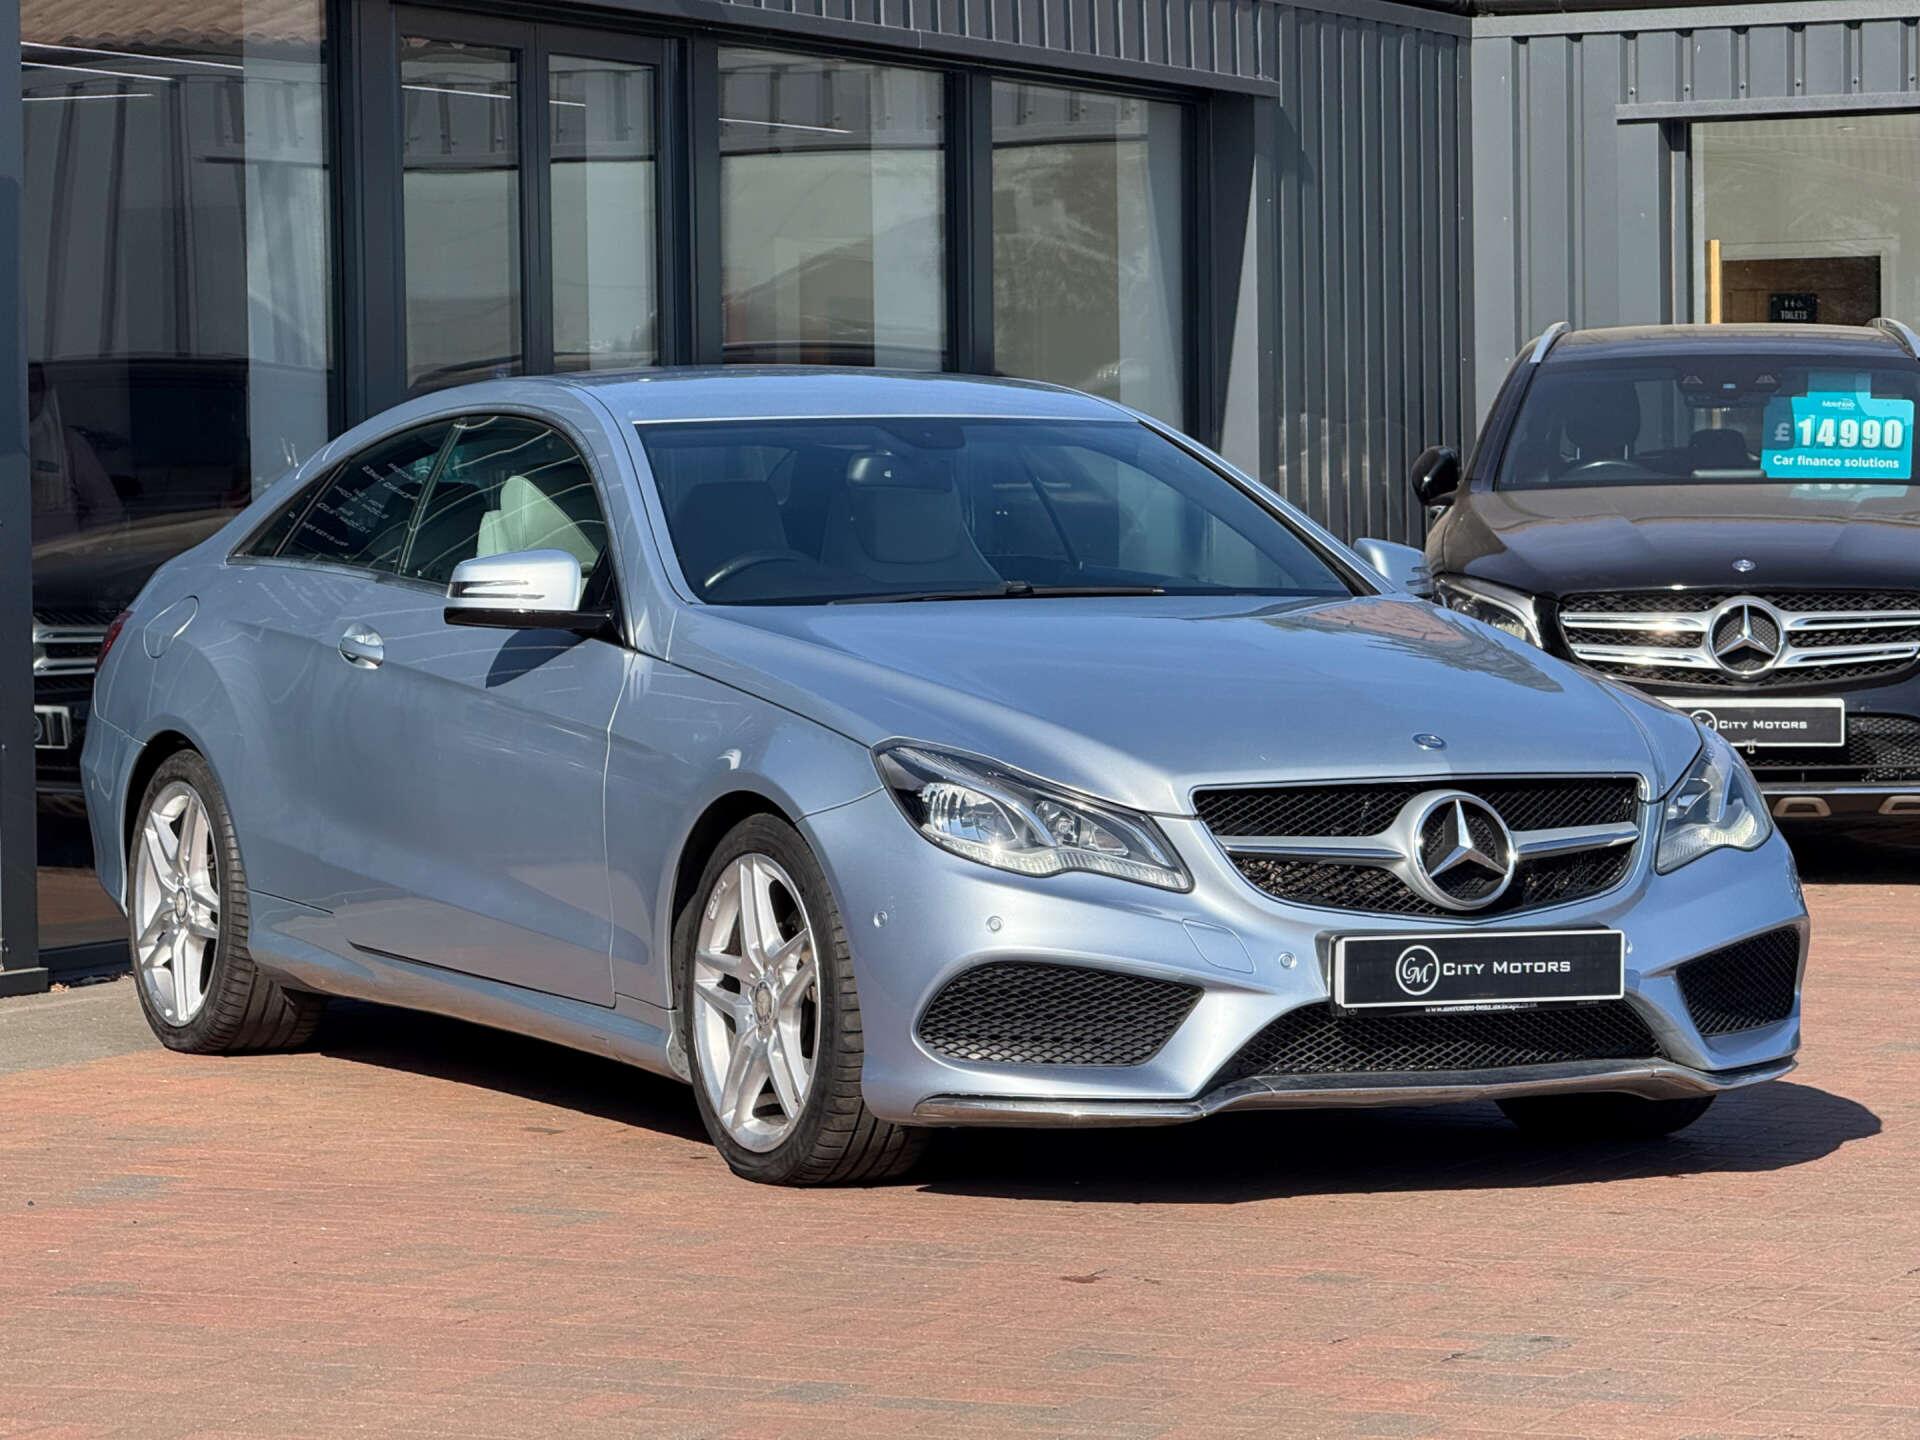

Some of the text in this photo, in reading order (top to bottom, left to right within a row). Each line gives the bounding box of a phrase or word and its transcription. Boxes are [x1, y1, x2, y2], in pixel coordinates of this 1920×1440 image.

[1780, 310, 1808, 320] TOILETS
[1772, 454, 1900, 469] Car finance solutions
